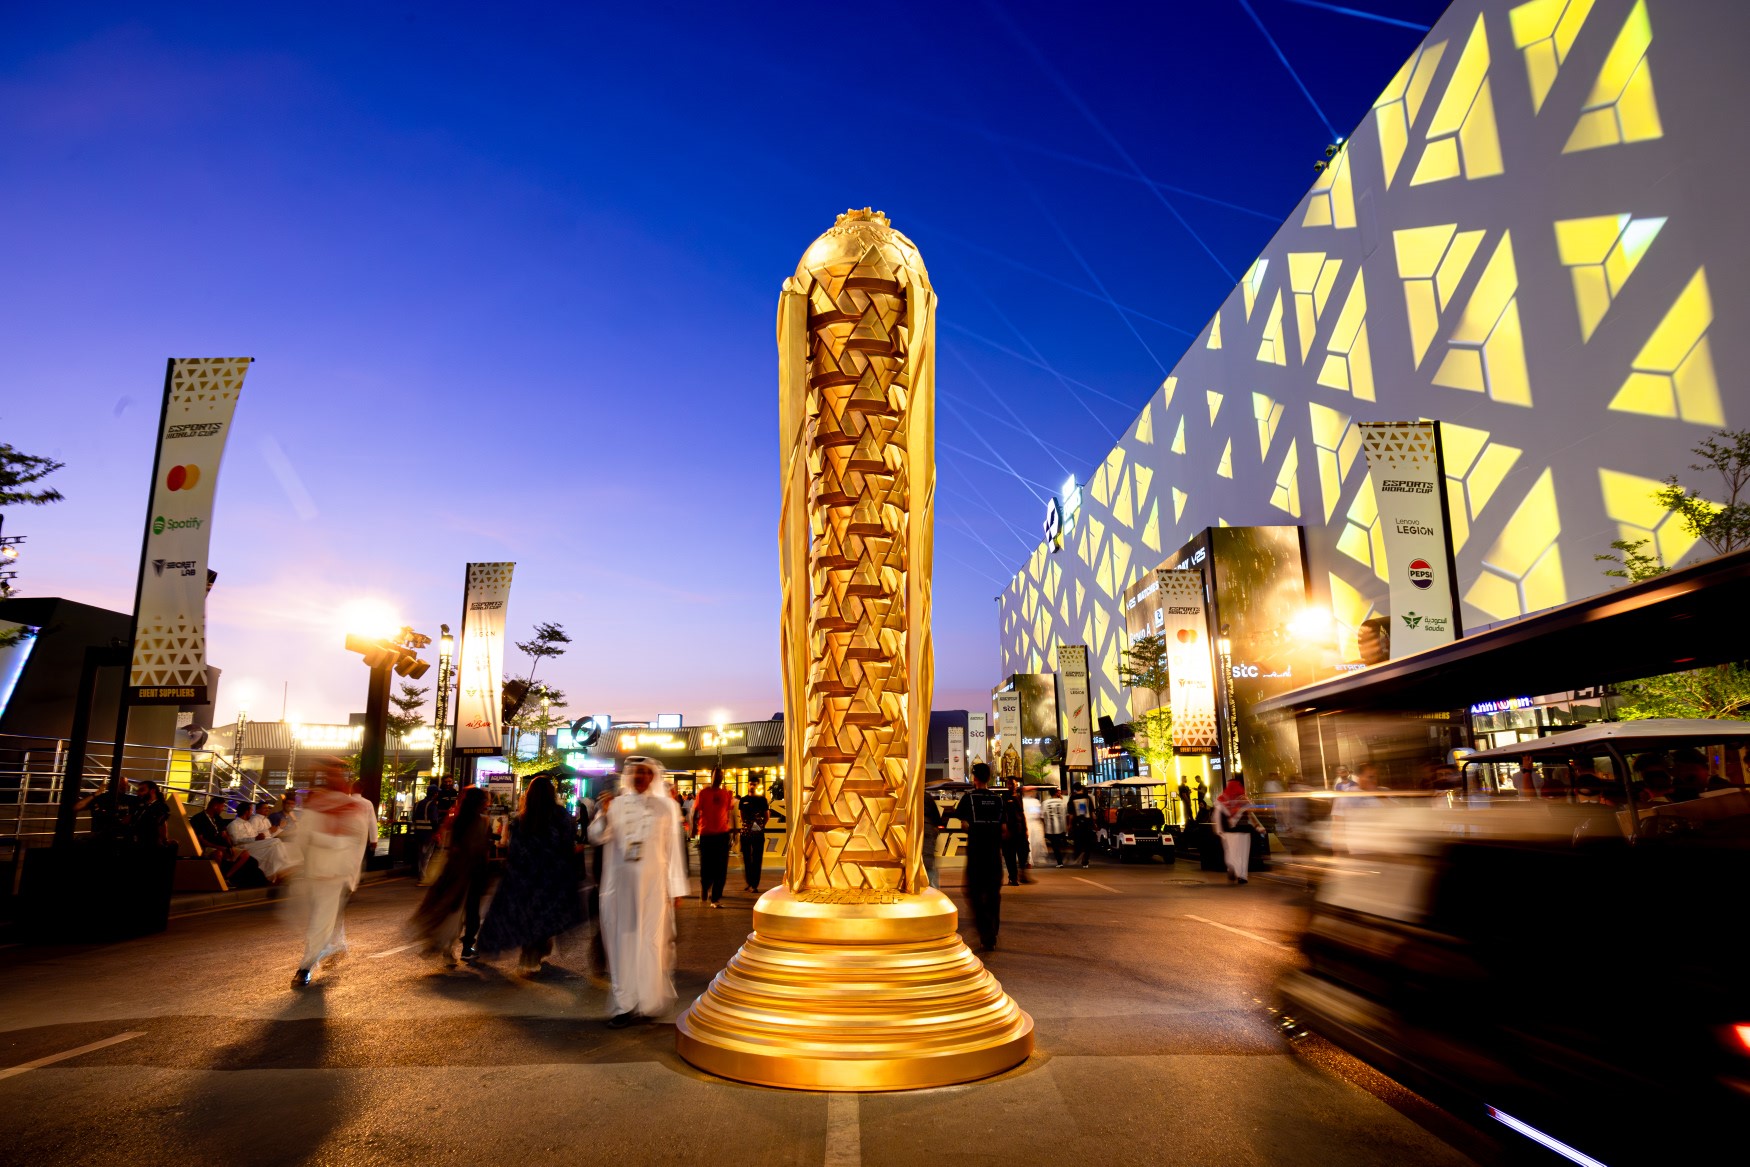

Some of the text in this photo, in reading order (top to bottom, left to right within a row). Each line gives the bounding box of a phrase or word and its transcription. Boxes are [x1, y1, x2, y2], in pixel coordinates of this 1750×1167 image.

[168, 422, 223, 433] ESPORTS
[197, 429, 219, 437] CUP
[1382, 480, 1434, 488] ESPORTS
[167, 516, 204, 531] Spotify
[1395, 518, 1420, 526] Lenovo
[1397, 525, 1434, 536] LEGION
[166, 560, 196, 569] SECRET
[181, 569, 196, 577] LAB
[1409, 570, 1433, 578] PEPSI
[1232, 661, 1259, 678] stc
[139, 688, 195, 698] EVENT SUPPLIERS
[969, 730, 985, 738] stc
